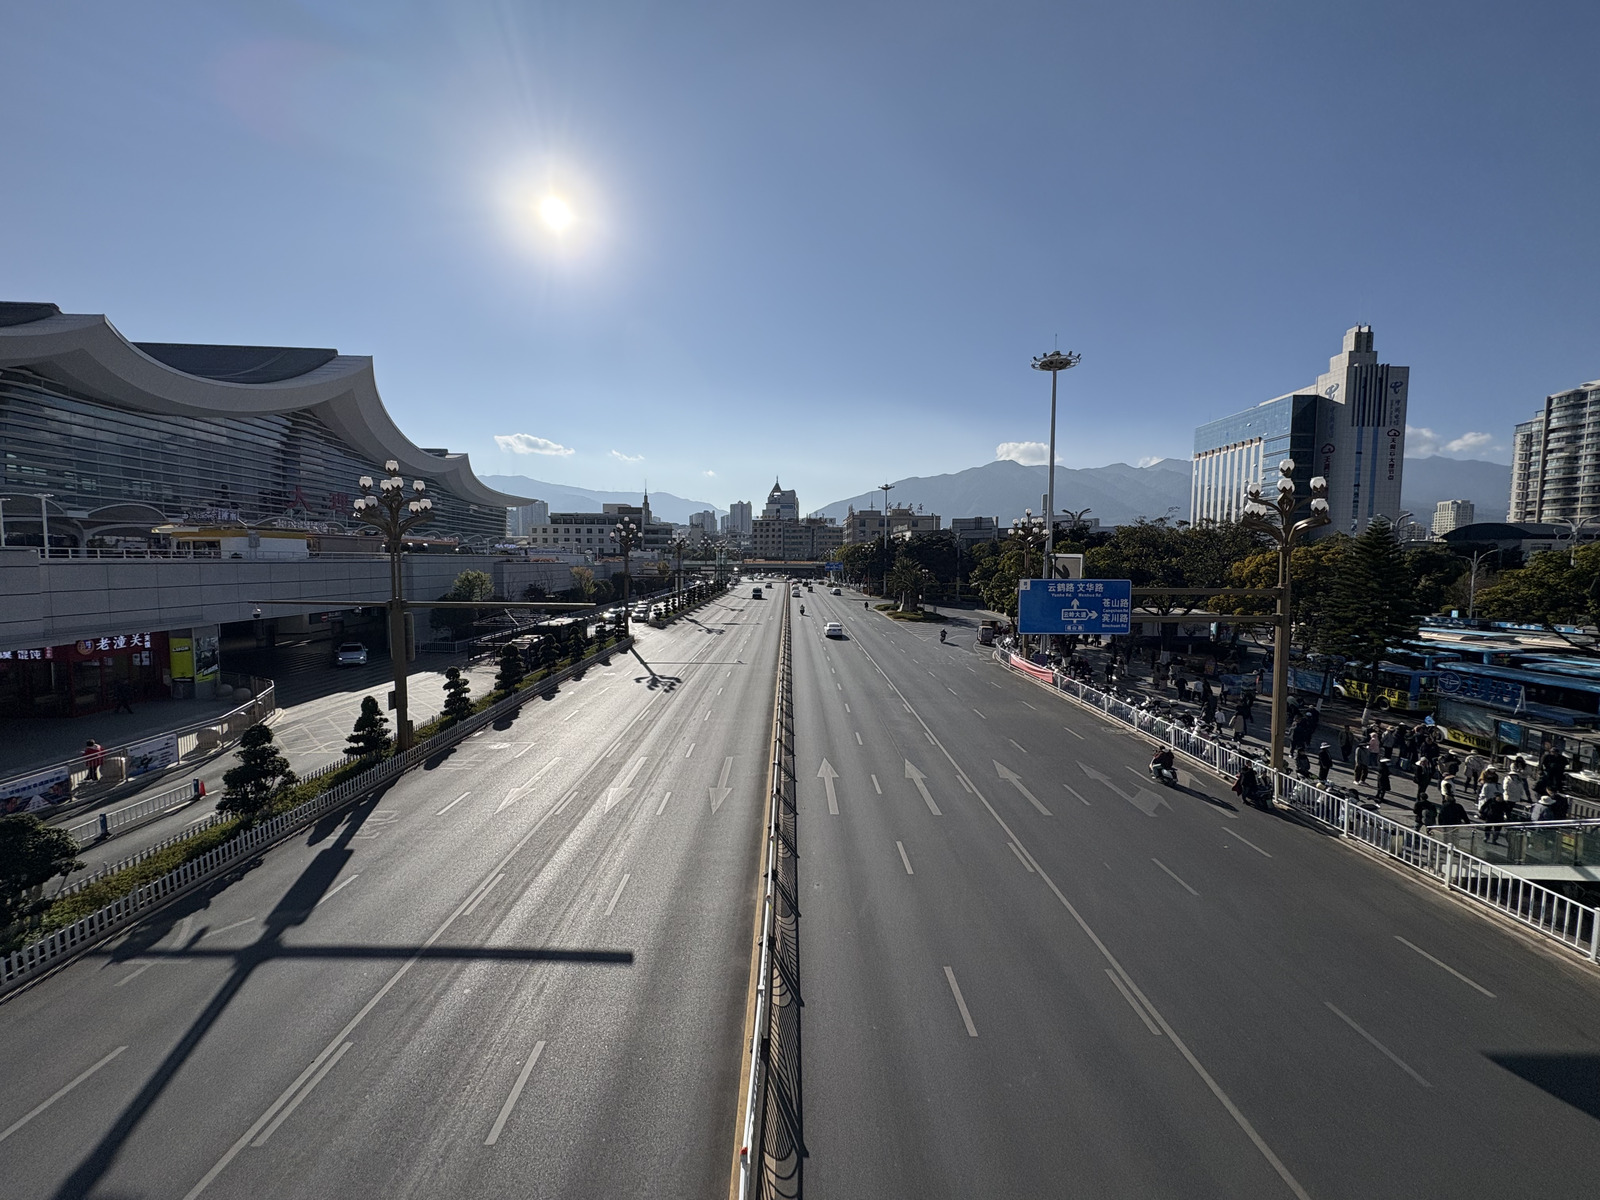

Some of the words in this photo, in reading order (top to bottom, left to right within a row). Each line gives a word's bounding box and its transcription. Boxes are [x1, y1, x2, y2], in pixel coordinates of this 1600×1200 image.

[1047, 583, 1075, 592] 云鹤路
[1077, 583, 1104, 592] 文华路
[1102, 598, 1129, 608] 苍山路
[1101, 613, 1129, 623] 宾川路
[95, 633, 143, 651] 老潼关
